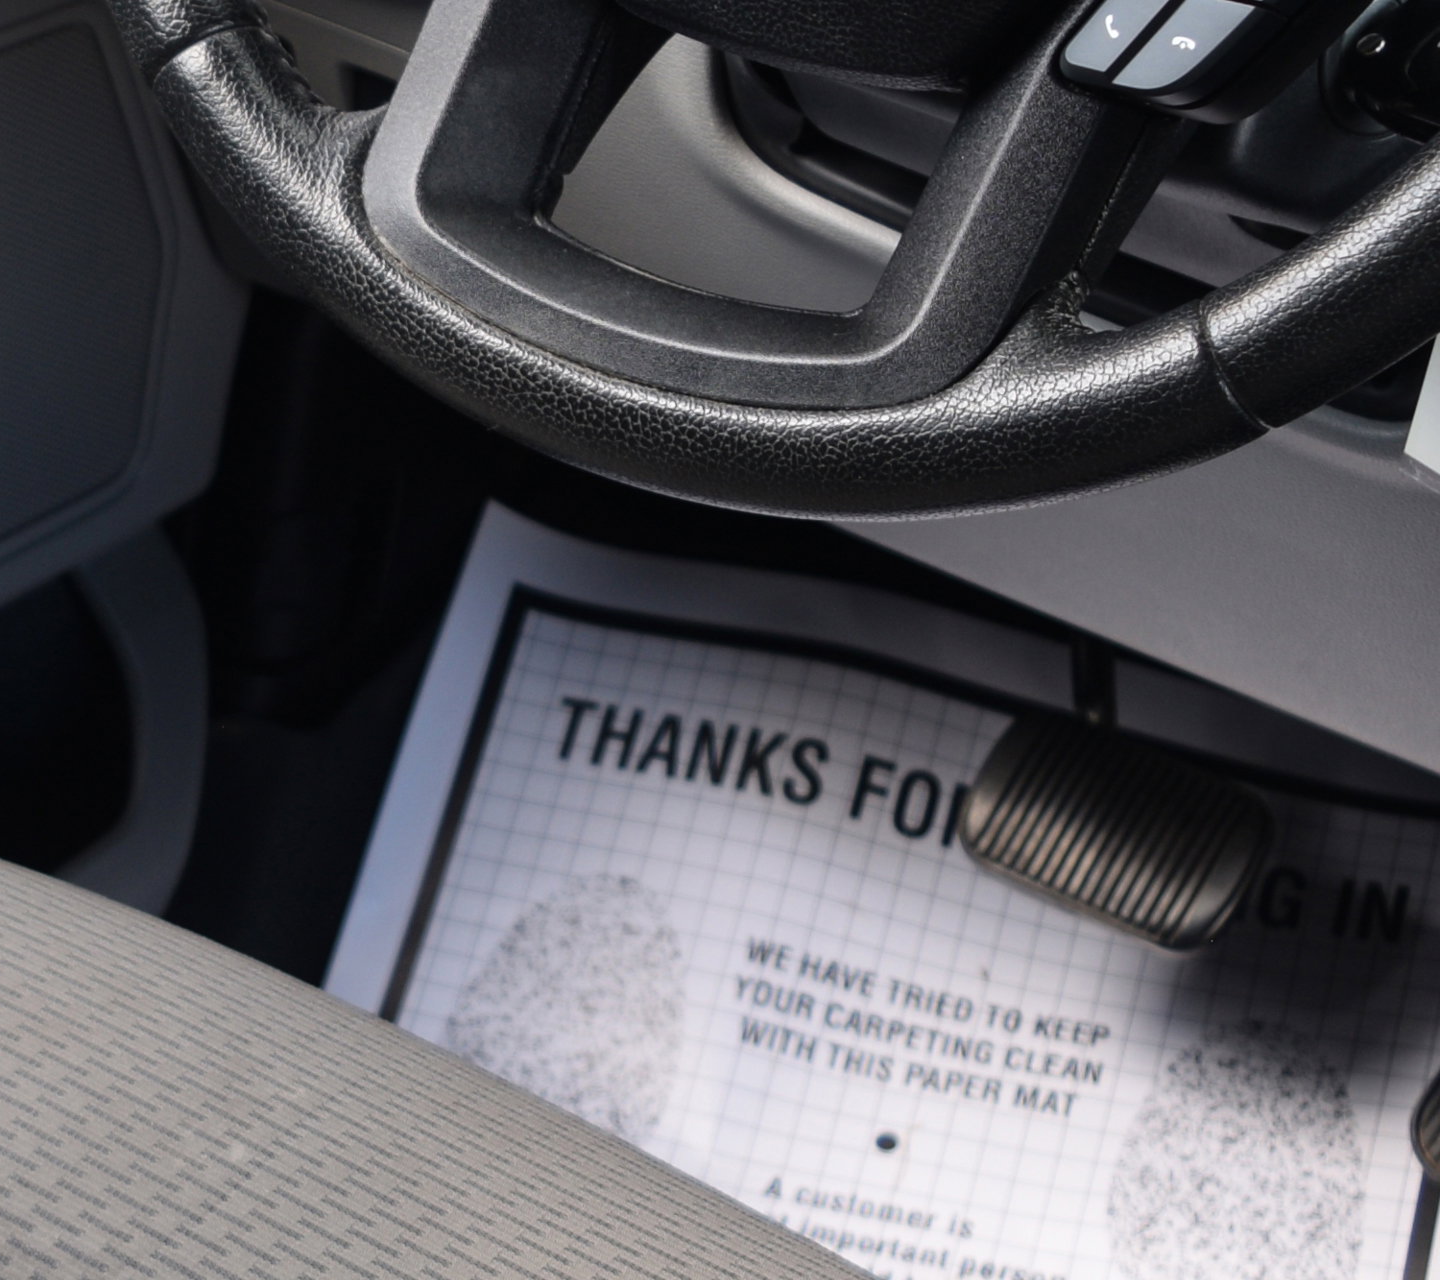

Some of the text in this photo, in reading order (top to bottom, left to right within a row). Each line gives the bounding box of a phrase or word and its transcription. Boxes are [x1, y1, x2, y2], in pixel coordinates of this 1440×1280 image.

[558, 696, 831, 807] THANKS
[735, 975, 1105, 1086] YOUR CARPETING CLEAN
[746, 936, 1112, 1048] WE HAVE TRIED TO KEEP
[740, 1016, 1081, 1119] WITH THIS PAPER MAT
[764, 1176, 784, 1200] A
[795, 1184, 937, 1232] customer
[948, 1214, 975, 1240] is
[800, 1218, 952, 1270] important
